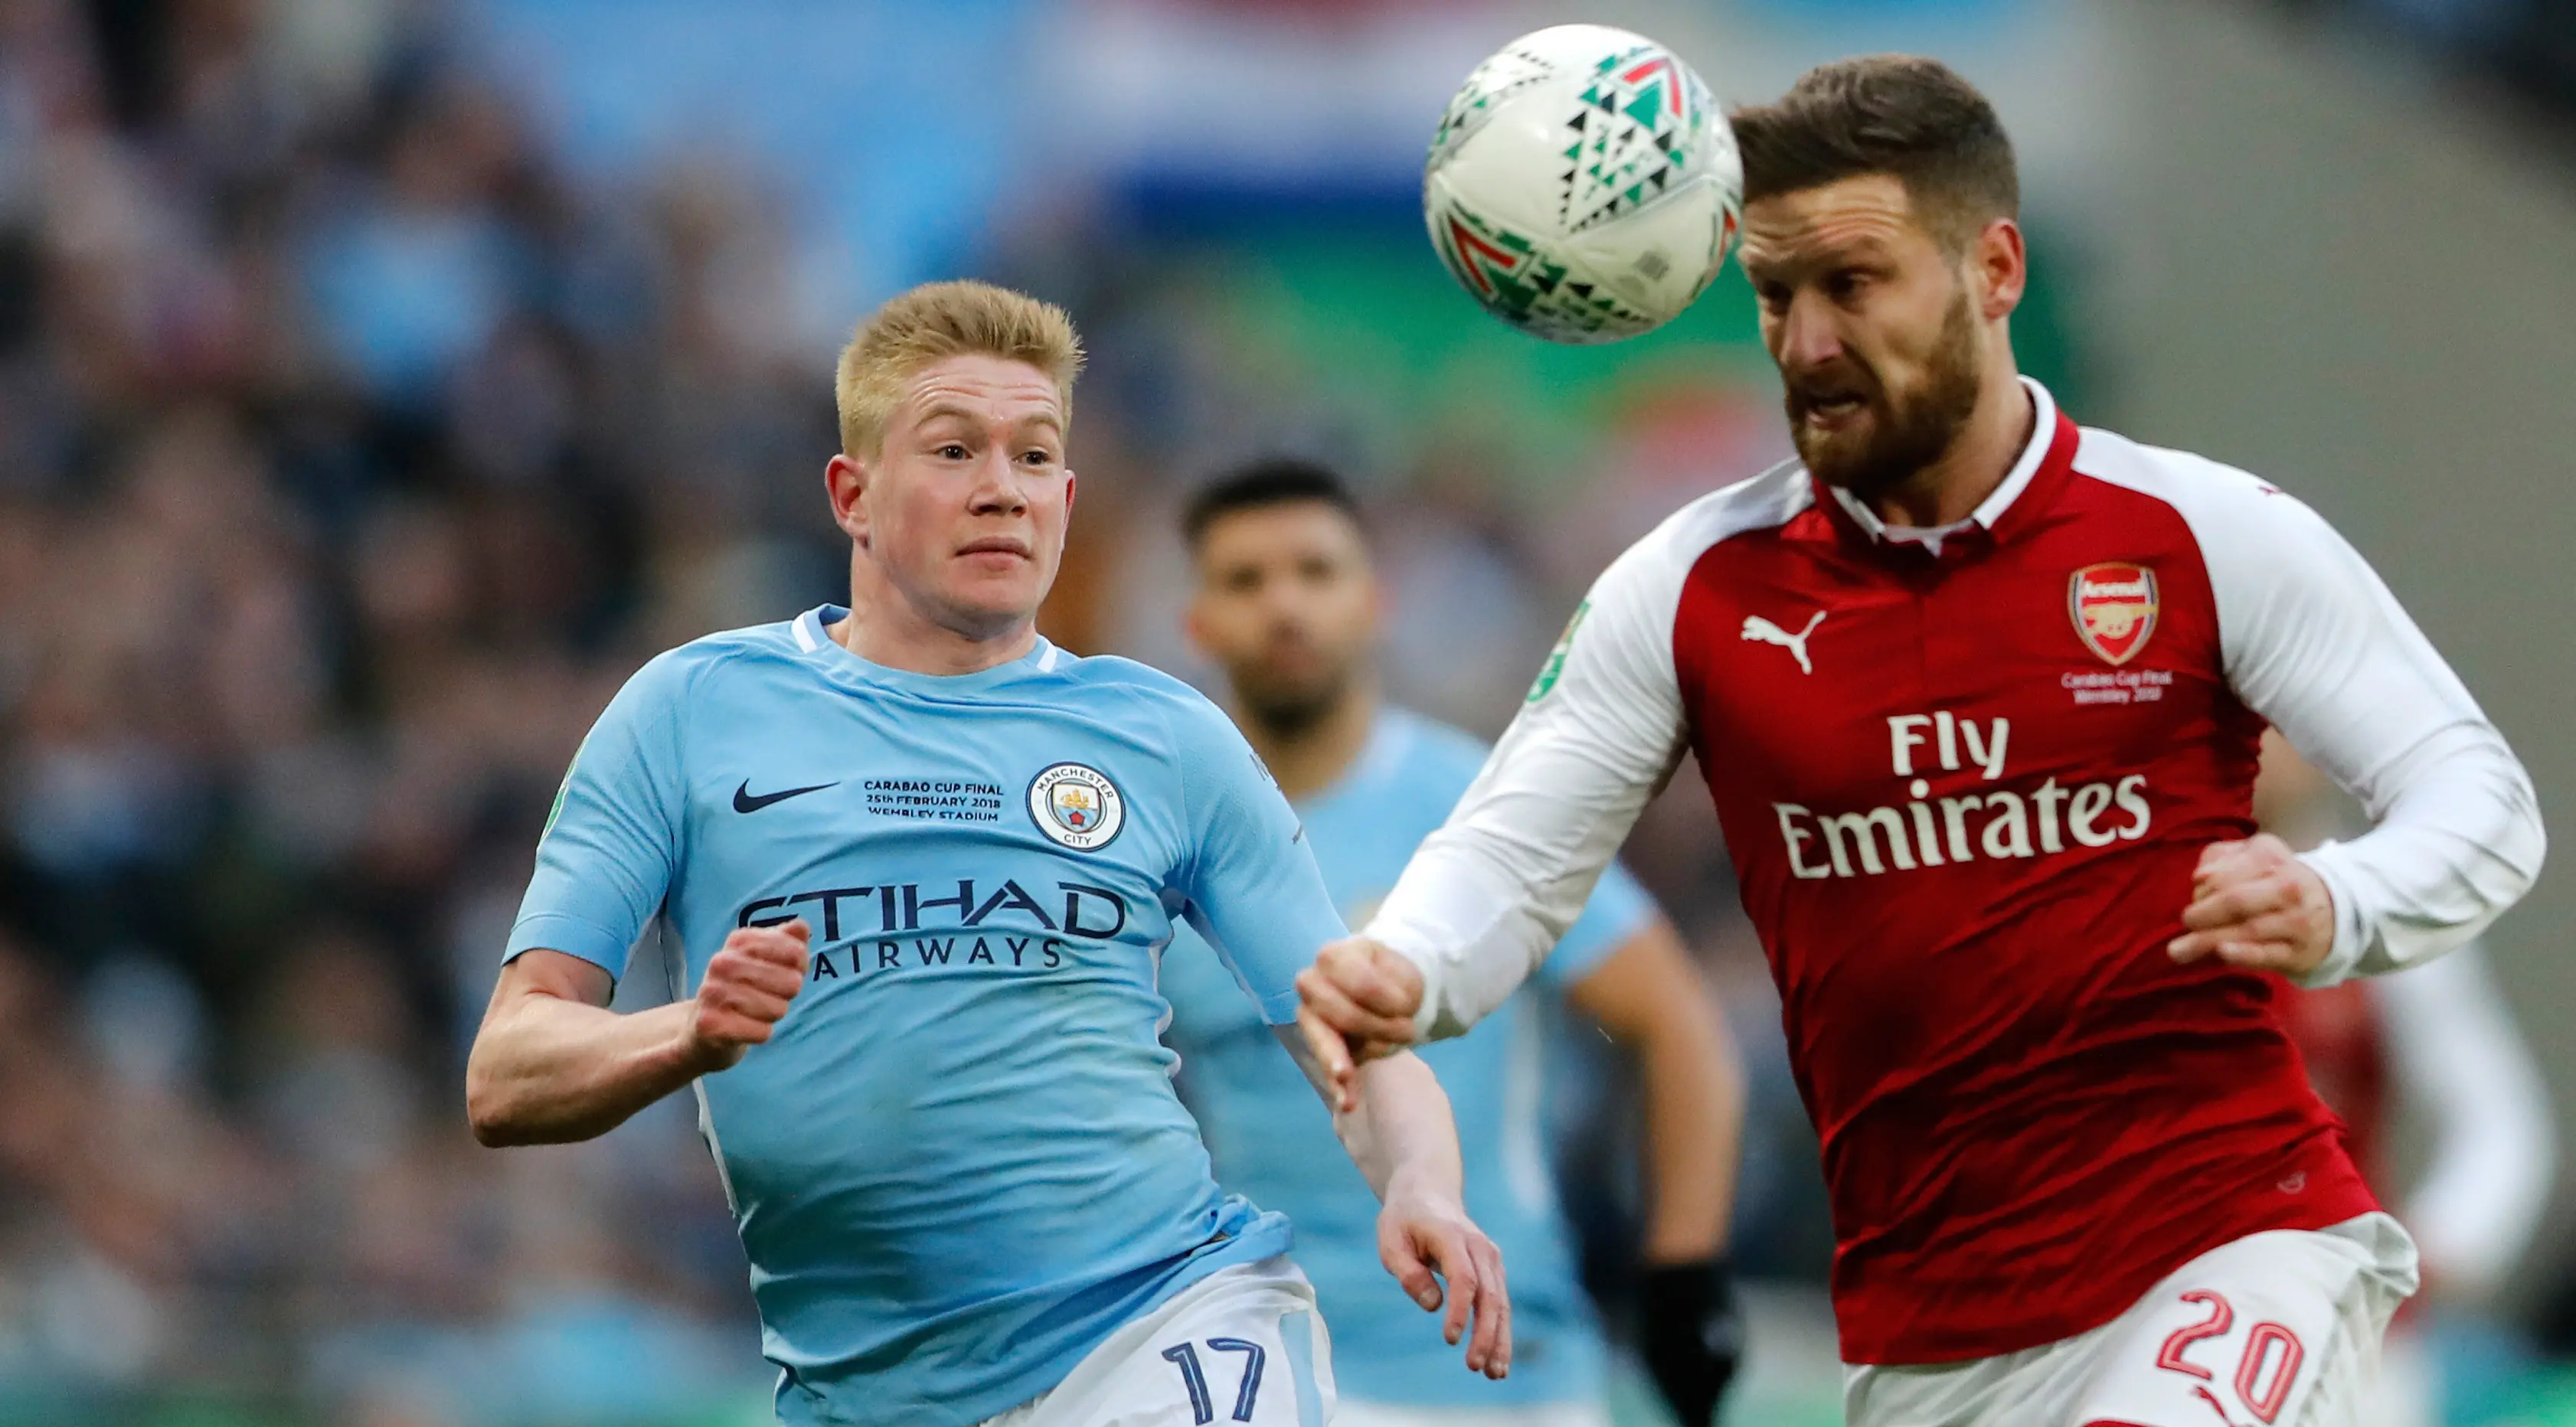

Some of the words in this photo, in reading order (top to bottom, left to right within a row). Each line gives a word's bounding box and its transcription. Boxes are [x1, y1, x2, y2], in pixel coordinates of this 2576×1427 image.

[1887, 710, 2010, 779] Fly
[864, 781, 931, 792] CARABAO
[934, 782, 961, 794] CUP
[965, 783, 1005, 796] FINAL
[866, 794, 894, 804] 25th
[897, 795, 967, 807] FEBRUARY
[971, 798, 1002, 808] 2018
[1037, 768, 1114, 798] MANCHESTER
[868, 806, 935, 818] WEMBLEY
[939, 811, 999, 821] STADIUM
[1771, 774, 2151, 879] Emirates
[1064, 834, 1092, 844] CITY
[812, 936, 1062, 981] AIRWAYS
[2156, 1288, 2305, 1425] 20
[1161, 1337, 1266, 1426] 17
